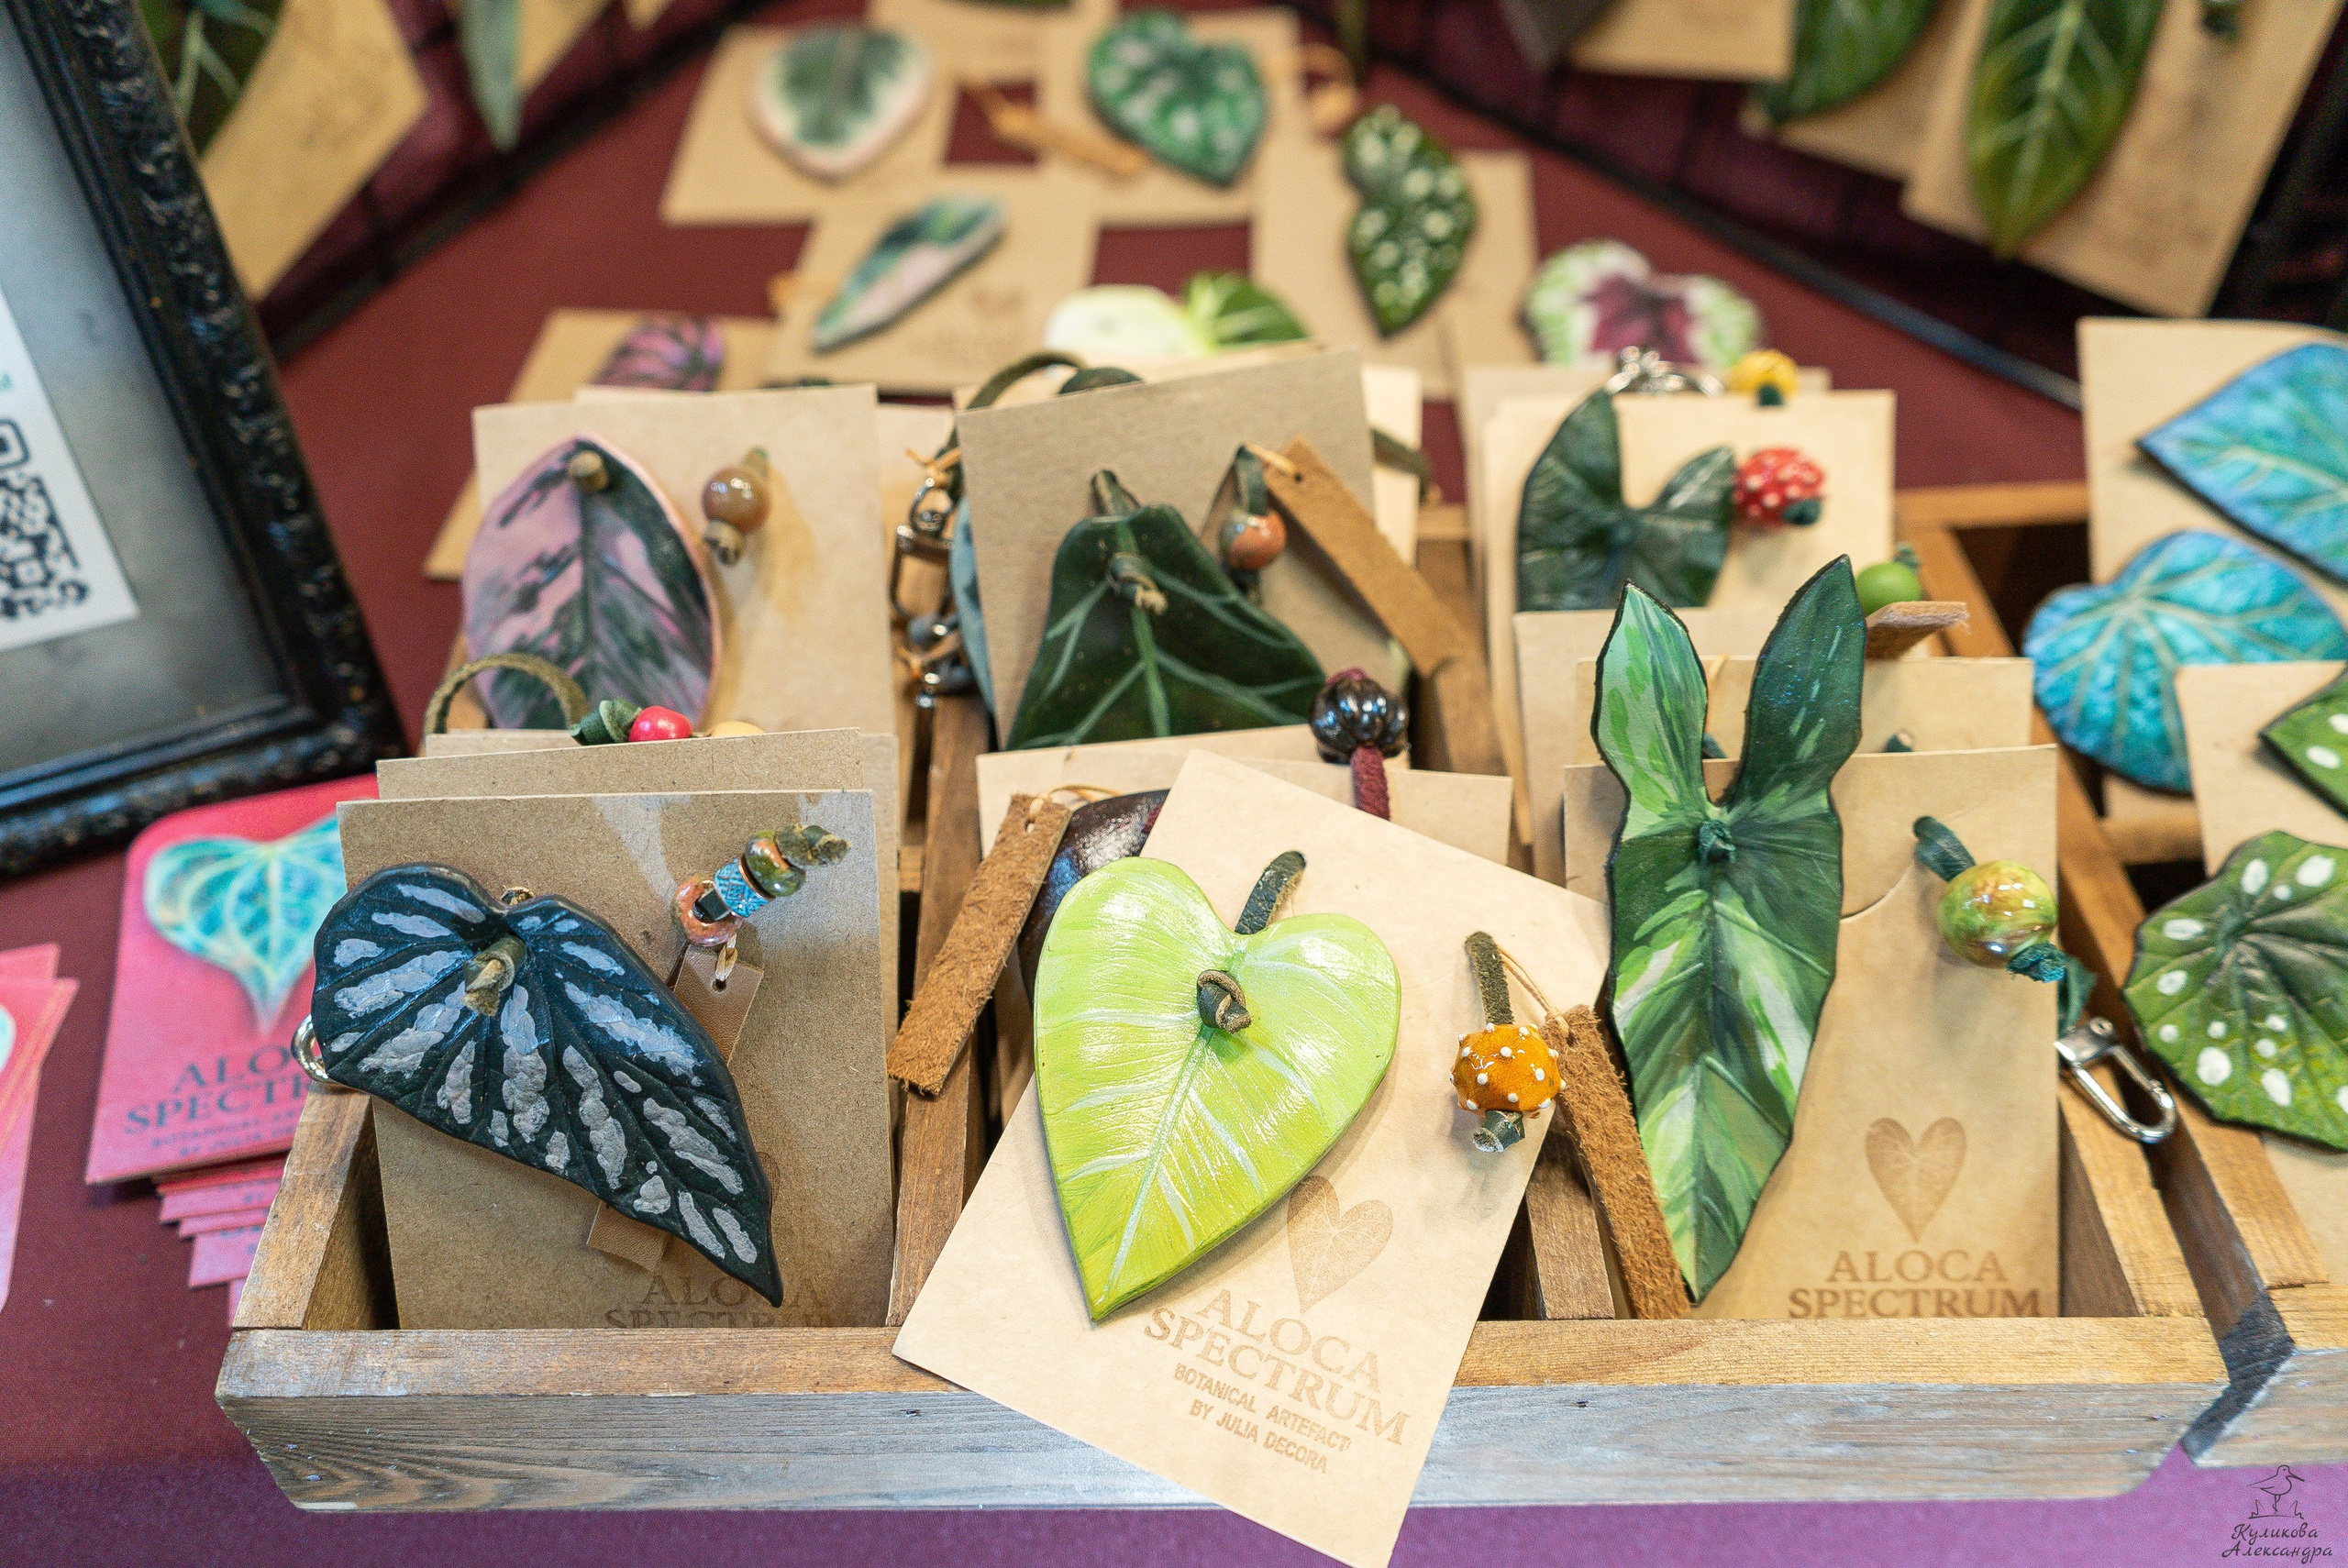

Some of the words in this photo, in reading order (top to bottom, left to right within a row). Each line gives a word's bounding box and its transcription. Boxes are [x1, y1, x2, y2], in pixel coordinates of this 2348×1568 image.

[171, 1044, 291, 1094] ALO
[123, 1073, 312, 1135] SPECTR
[642, 1274, 831, 1308] ALOA
[1827, 1248, 2009, 1284] ALOCA
[1789, 1287, 2041, 1319] SPECTRUM
[1196, 1288, 1381, 1394] ALOCA
[1144, 1307, 1412, 1446] SPECTRUM
[1174, 1363, 1257, 1414] BOTANICAL
[1265, 1404, 1352, 1452] ARTEFACT
[1189, 1398, 1214, 1421] BY
[1216, 1411, 1259, 1443] JULIA
[1262, 1430, 1328, 1474] DECORA
